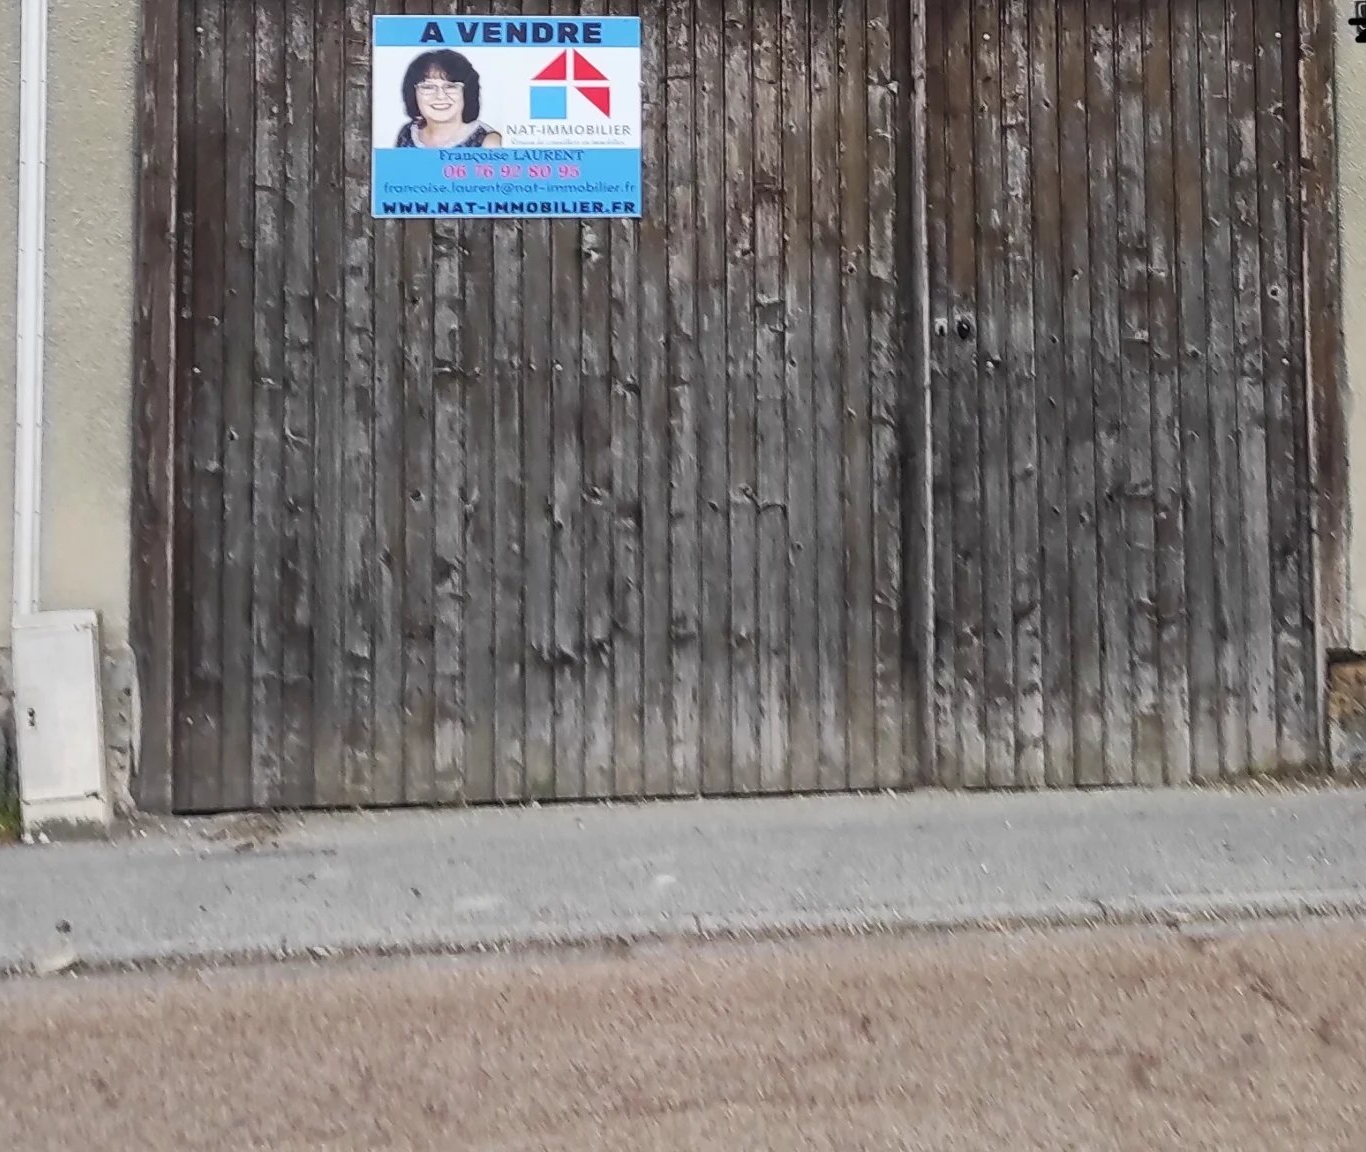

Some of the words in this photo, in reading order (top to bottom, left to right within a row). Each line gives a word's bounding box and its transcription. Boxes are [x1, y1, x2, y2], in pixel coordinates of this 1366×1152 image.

[420, 21, 445, 43] A
[456, 22, 602, 44] VENDRE
[506, 124, 632, 136] NAT-IMMOBILIER
[439, 149, 509, 163] Françoise
[513, 149, 585, 161] LAURENT
[443, 164, 467, 179] 06
[528, 164, 552, 179] 80
[383, 181, 636, 195] francoise.laurent@nat-immobilier.fr
[382, 201, 636, 215] WWW.NAT-IMMOBILIER.FR
